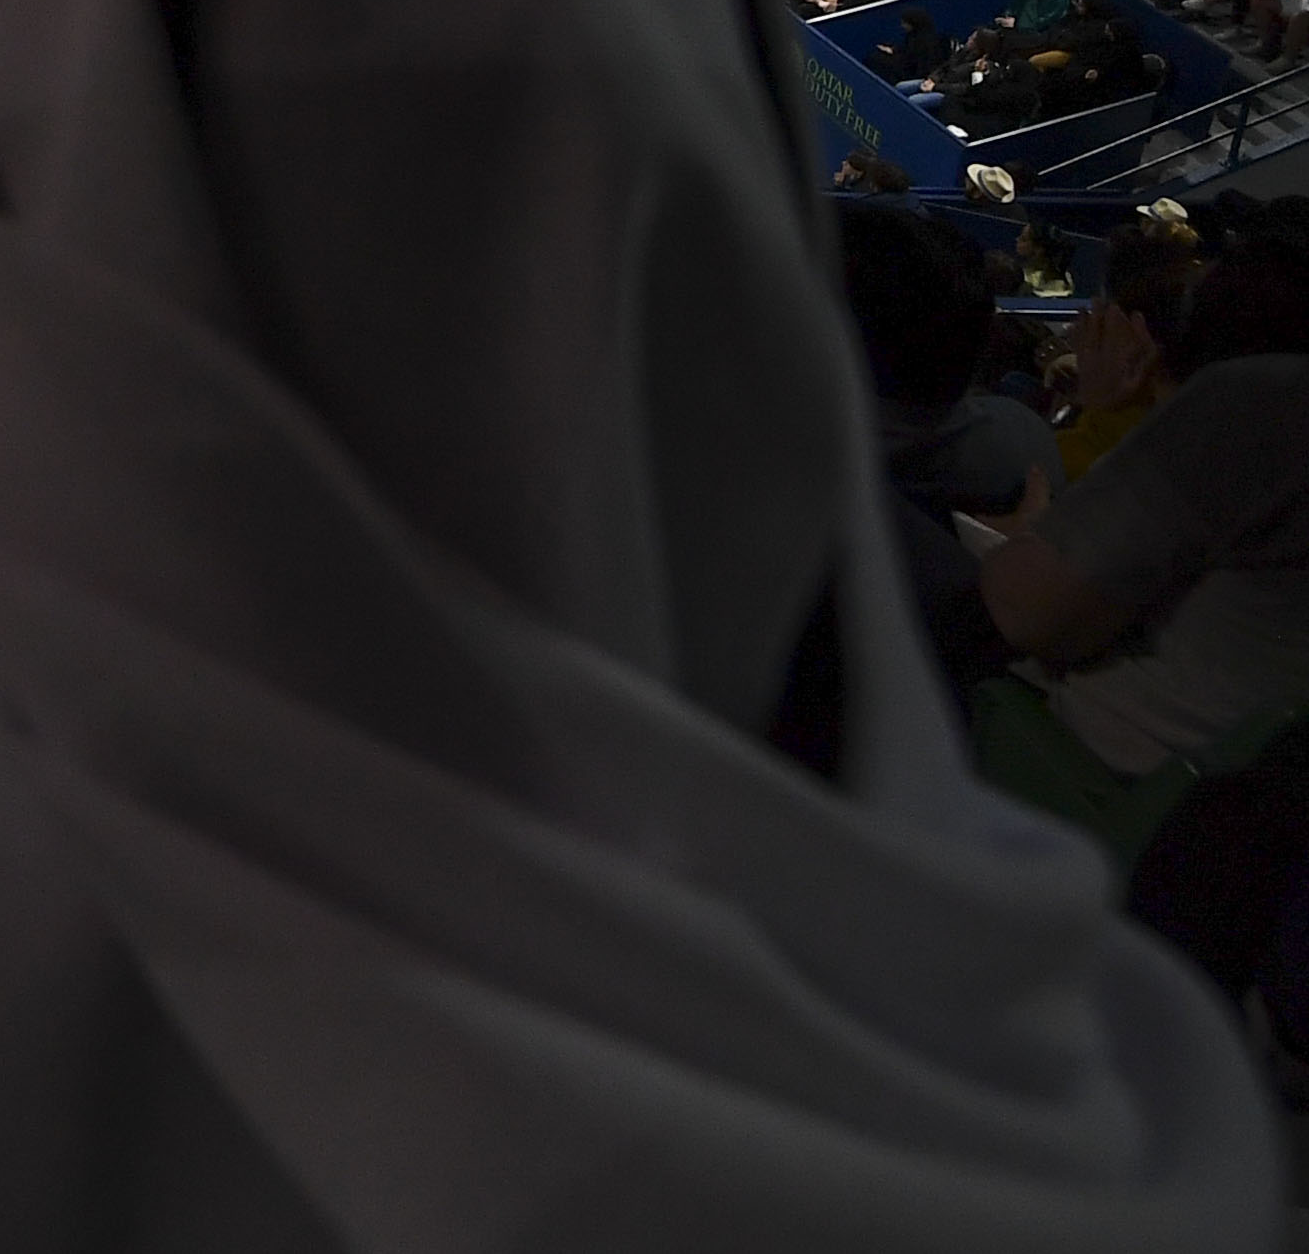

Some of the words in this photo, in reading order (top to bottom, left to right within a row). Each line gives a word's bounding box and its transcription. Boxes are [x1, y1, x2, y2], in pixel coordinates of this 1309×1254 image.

[804, 72, 844, 117] DUTY
[845, 107, 880, 150] FREE
[807, 58, 854, 107] QATAR
